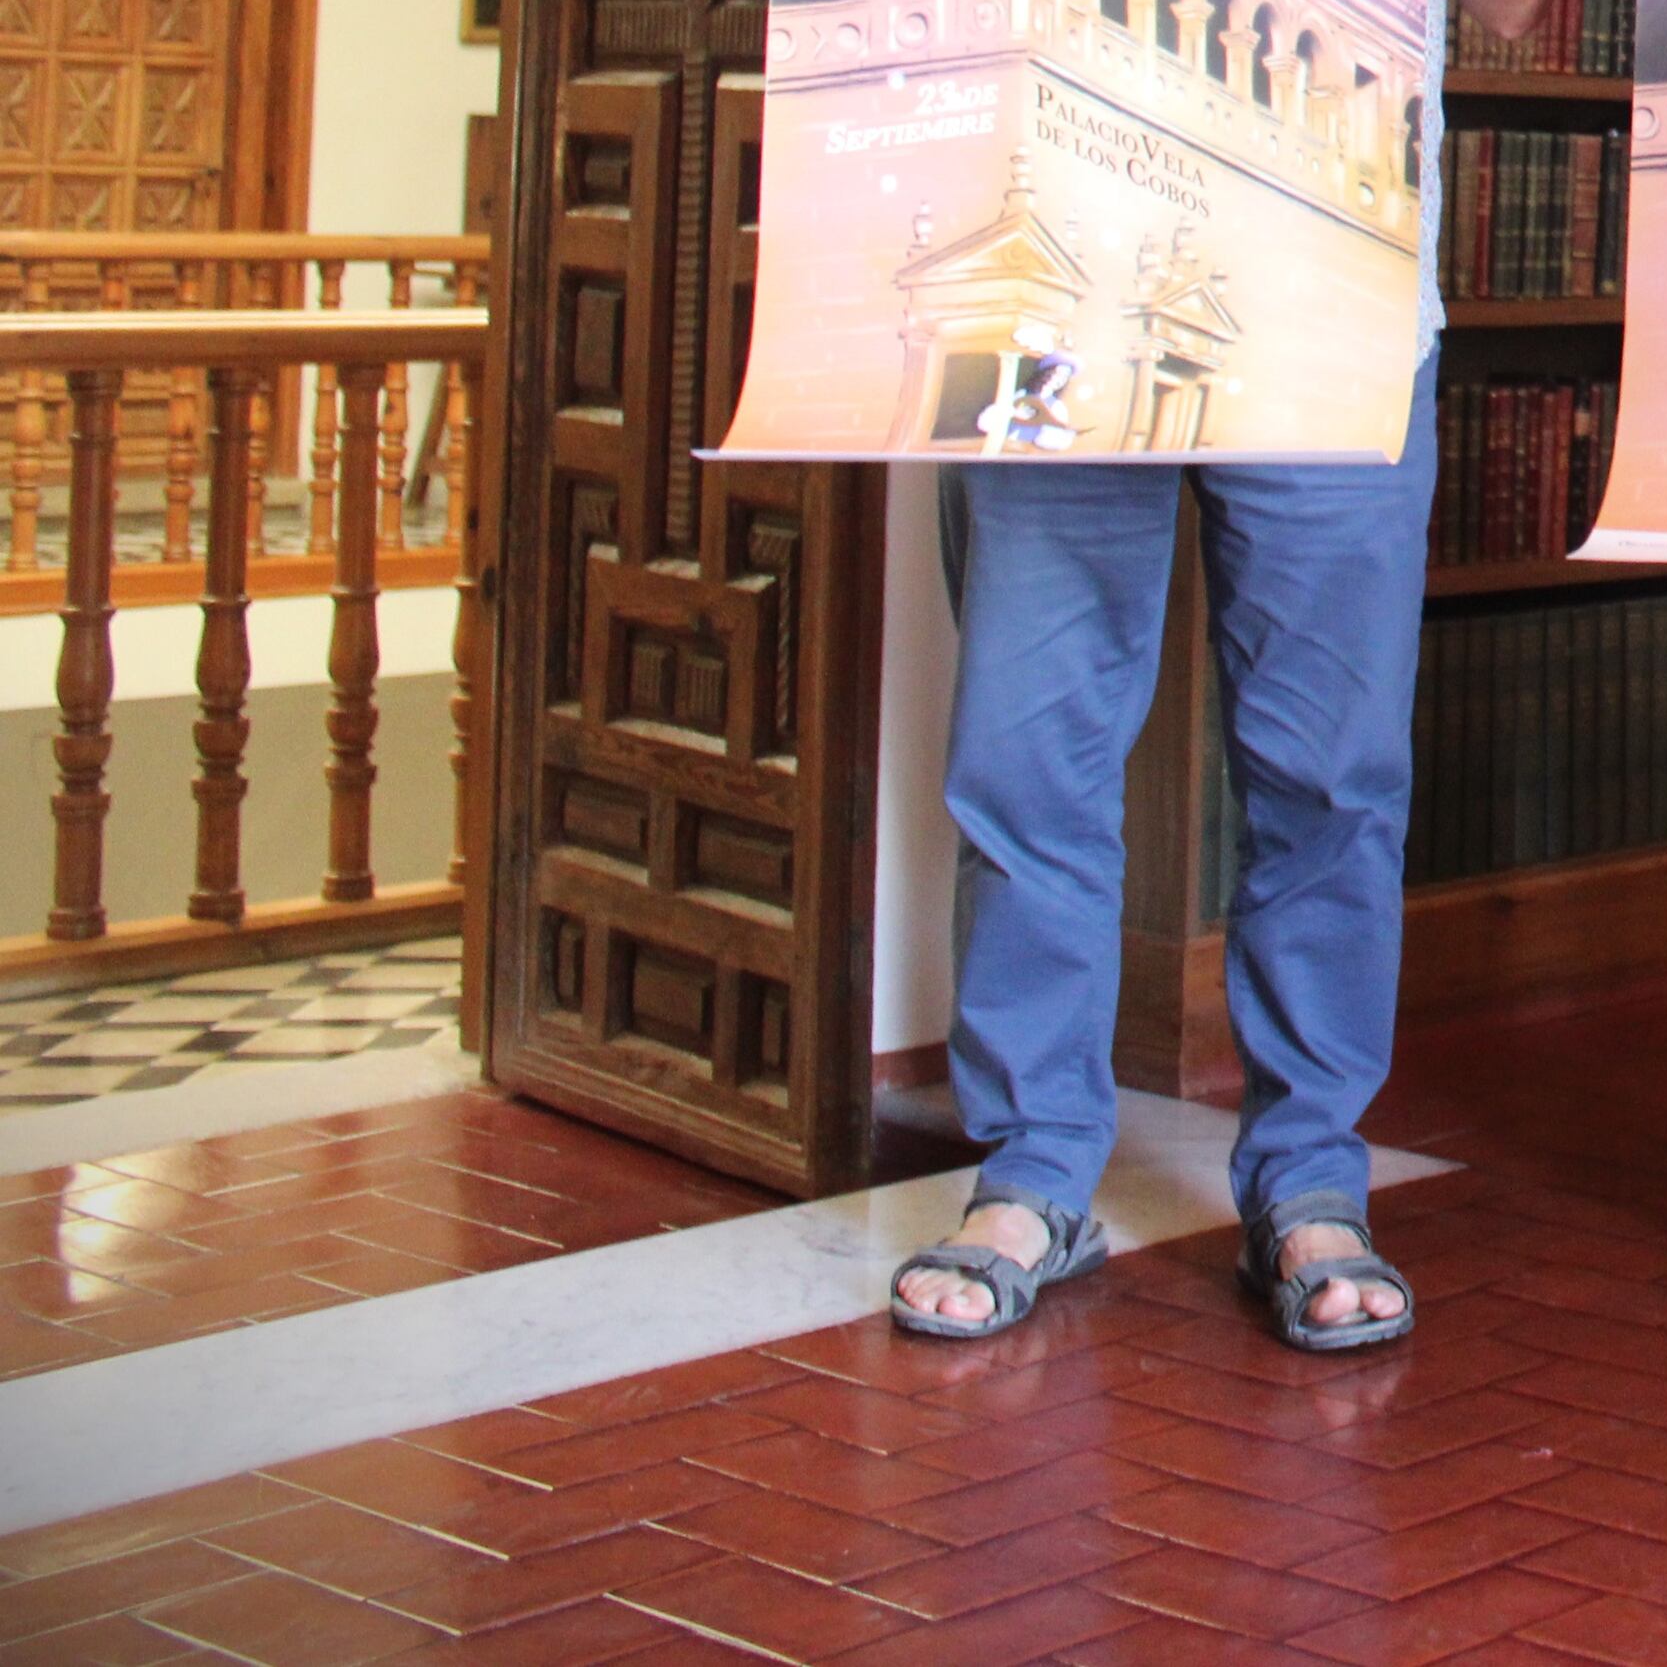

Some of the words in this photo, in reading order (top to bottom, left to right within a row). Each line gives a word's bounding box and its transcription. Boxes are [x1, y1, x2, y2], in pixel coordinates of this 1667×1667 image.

[1036, 118, 1067, 149] DE
[1075, 136, 1117, 174] LOS
[1126, 157, 1210, 219] COBOS
